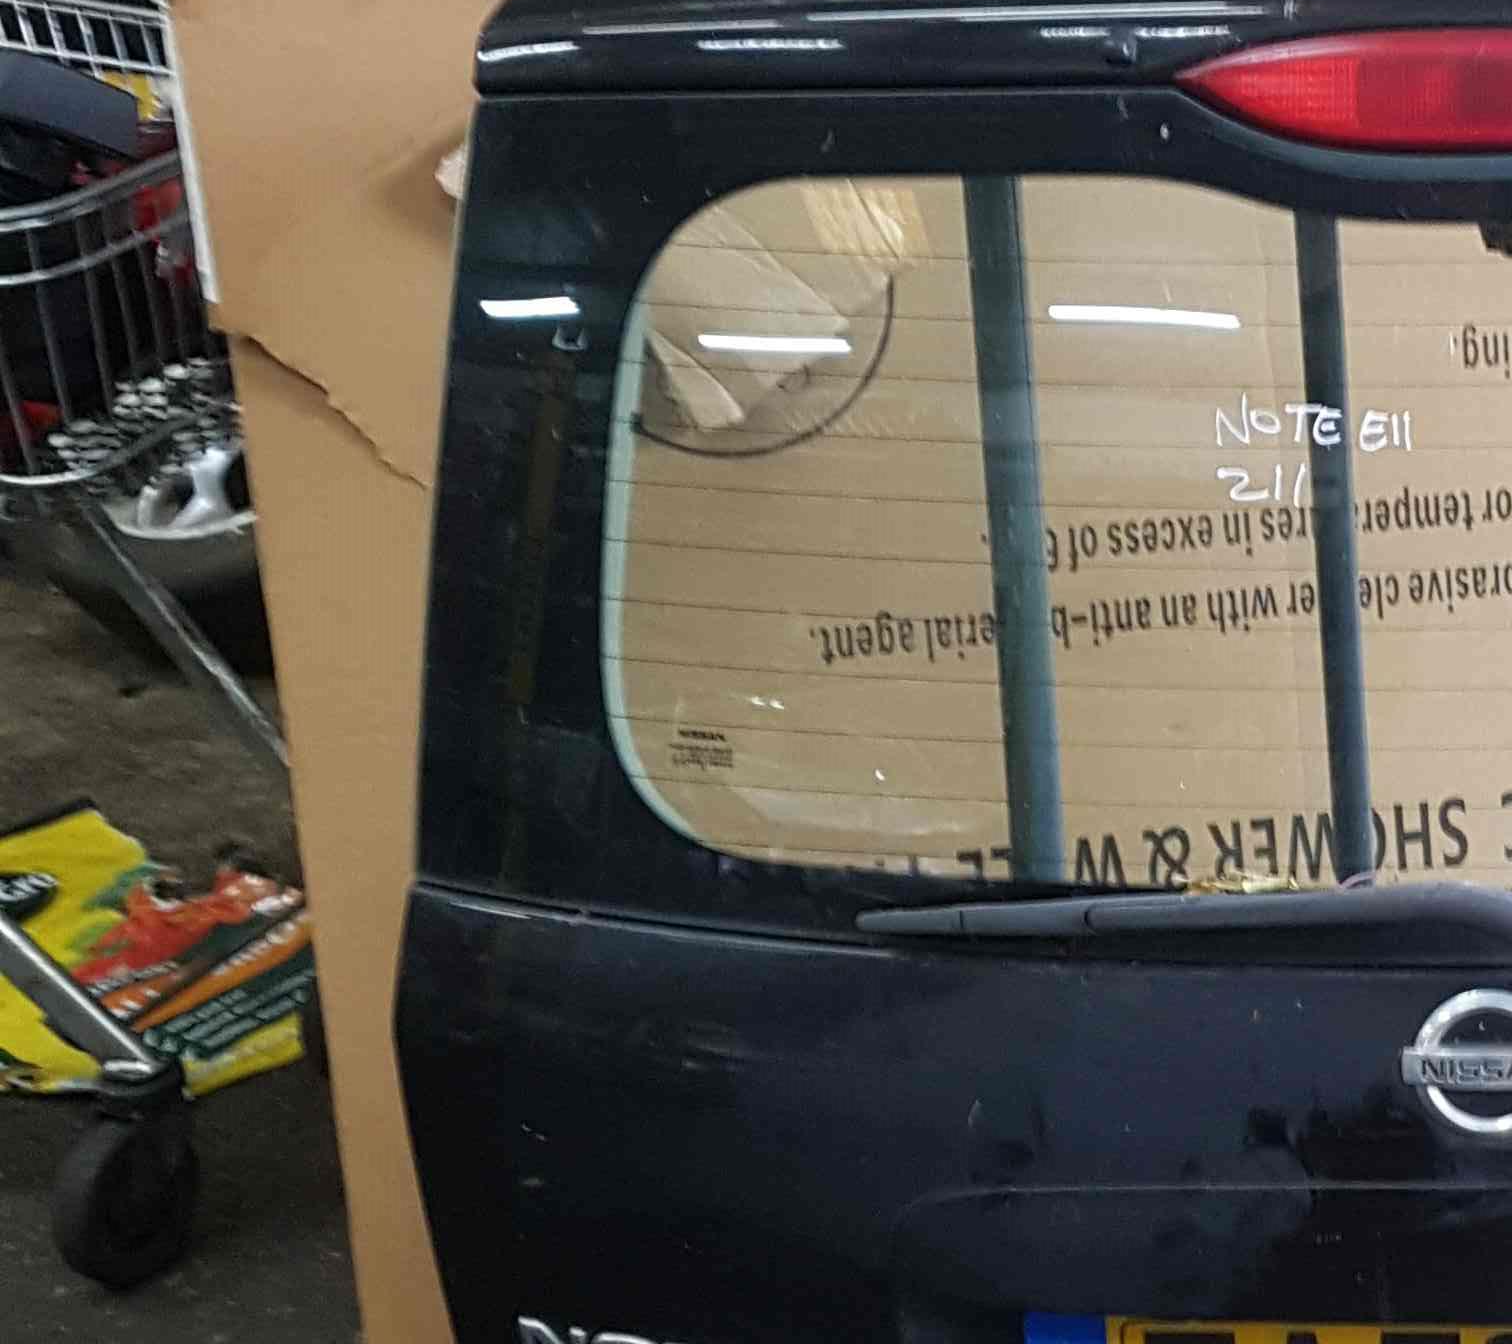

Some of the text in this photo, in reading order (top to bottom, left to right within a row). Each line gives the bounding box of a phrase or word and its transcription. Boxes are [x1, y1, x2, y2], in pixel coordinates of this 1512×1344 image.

[1260, 487, 1474, 541] temperres
[1478, 490, 1512, 524] or
[1069, 525, 1098, 573] of
[1106, 513, 1213, 560] excess
[1222, 512, 1253, 557] in
[1161, 593, 1197, 628] an
[1206, 585, 1277, 634] with
[1286, 574, 1400, 621] cleer
[808, 612, 913, 668] agent.
[924, 598, 1151, 664] anti-berial
